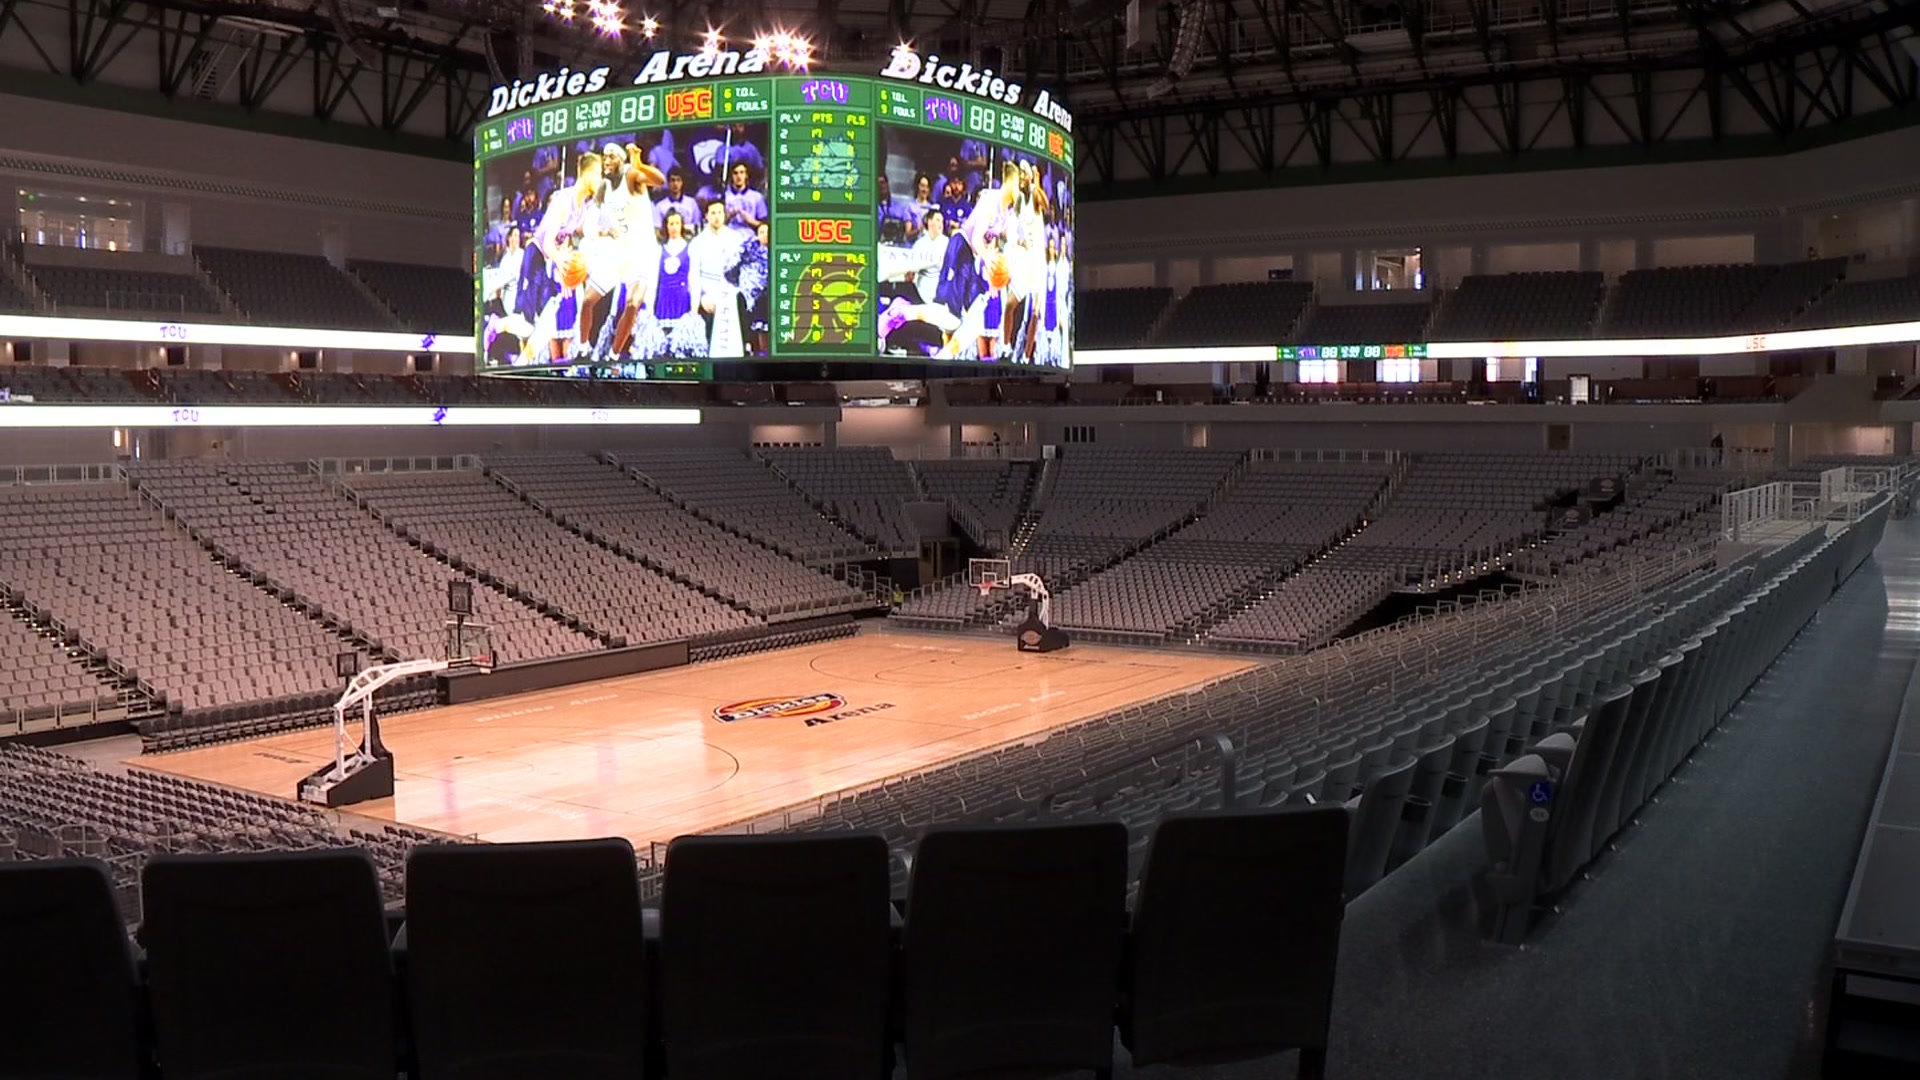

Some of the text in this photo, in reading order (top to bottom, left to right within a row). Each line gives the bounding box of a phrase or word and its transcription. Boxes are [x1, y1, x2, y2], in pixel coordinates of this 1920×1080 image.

[487, 49, 766, 118] Dickies Arena
[724, 88, 732, 98] 6
[801, 80, 849, 104] TCU
[880, 48, 1073, 133] Dickies Arena
[576, 100, 612, 121] 12:00
[621, 95, 655, 124] 88
[665, 89, 713, 117] USC
[724, 100, 768, 112] 9 FOULS
[893, 106, 916, 118] FOULS
[925, 96, 962, 126] TCU
[541, 108, 568, 137] 88
[812, 113, 833, 123] PTS
[846, 115, 866, 126] FLS
[970, 105, 995, 133] 88
[1029, 122, 1046, 149] 88
[799, 219, 852, 243] USC
[160, 325, 187, 340] TCU
[1745, 335, 1767, 351] USC
[172, 408, 199, 423] TCU
[804, 702, 896, 727] Arena
